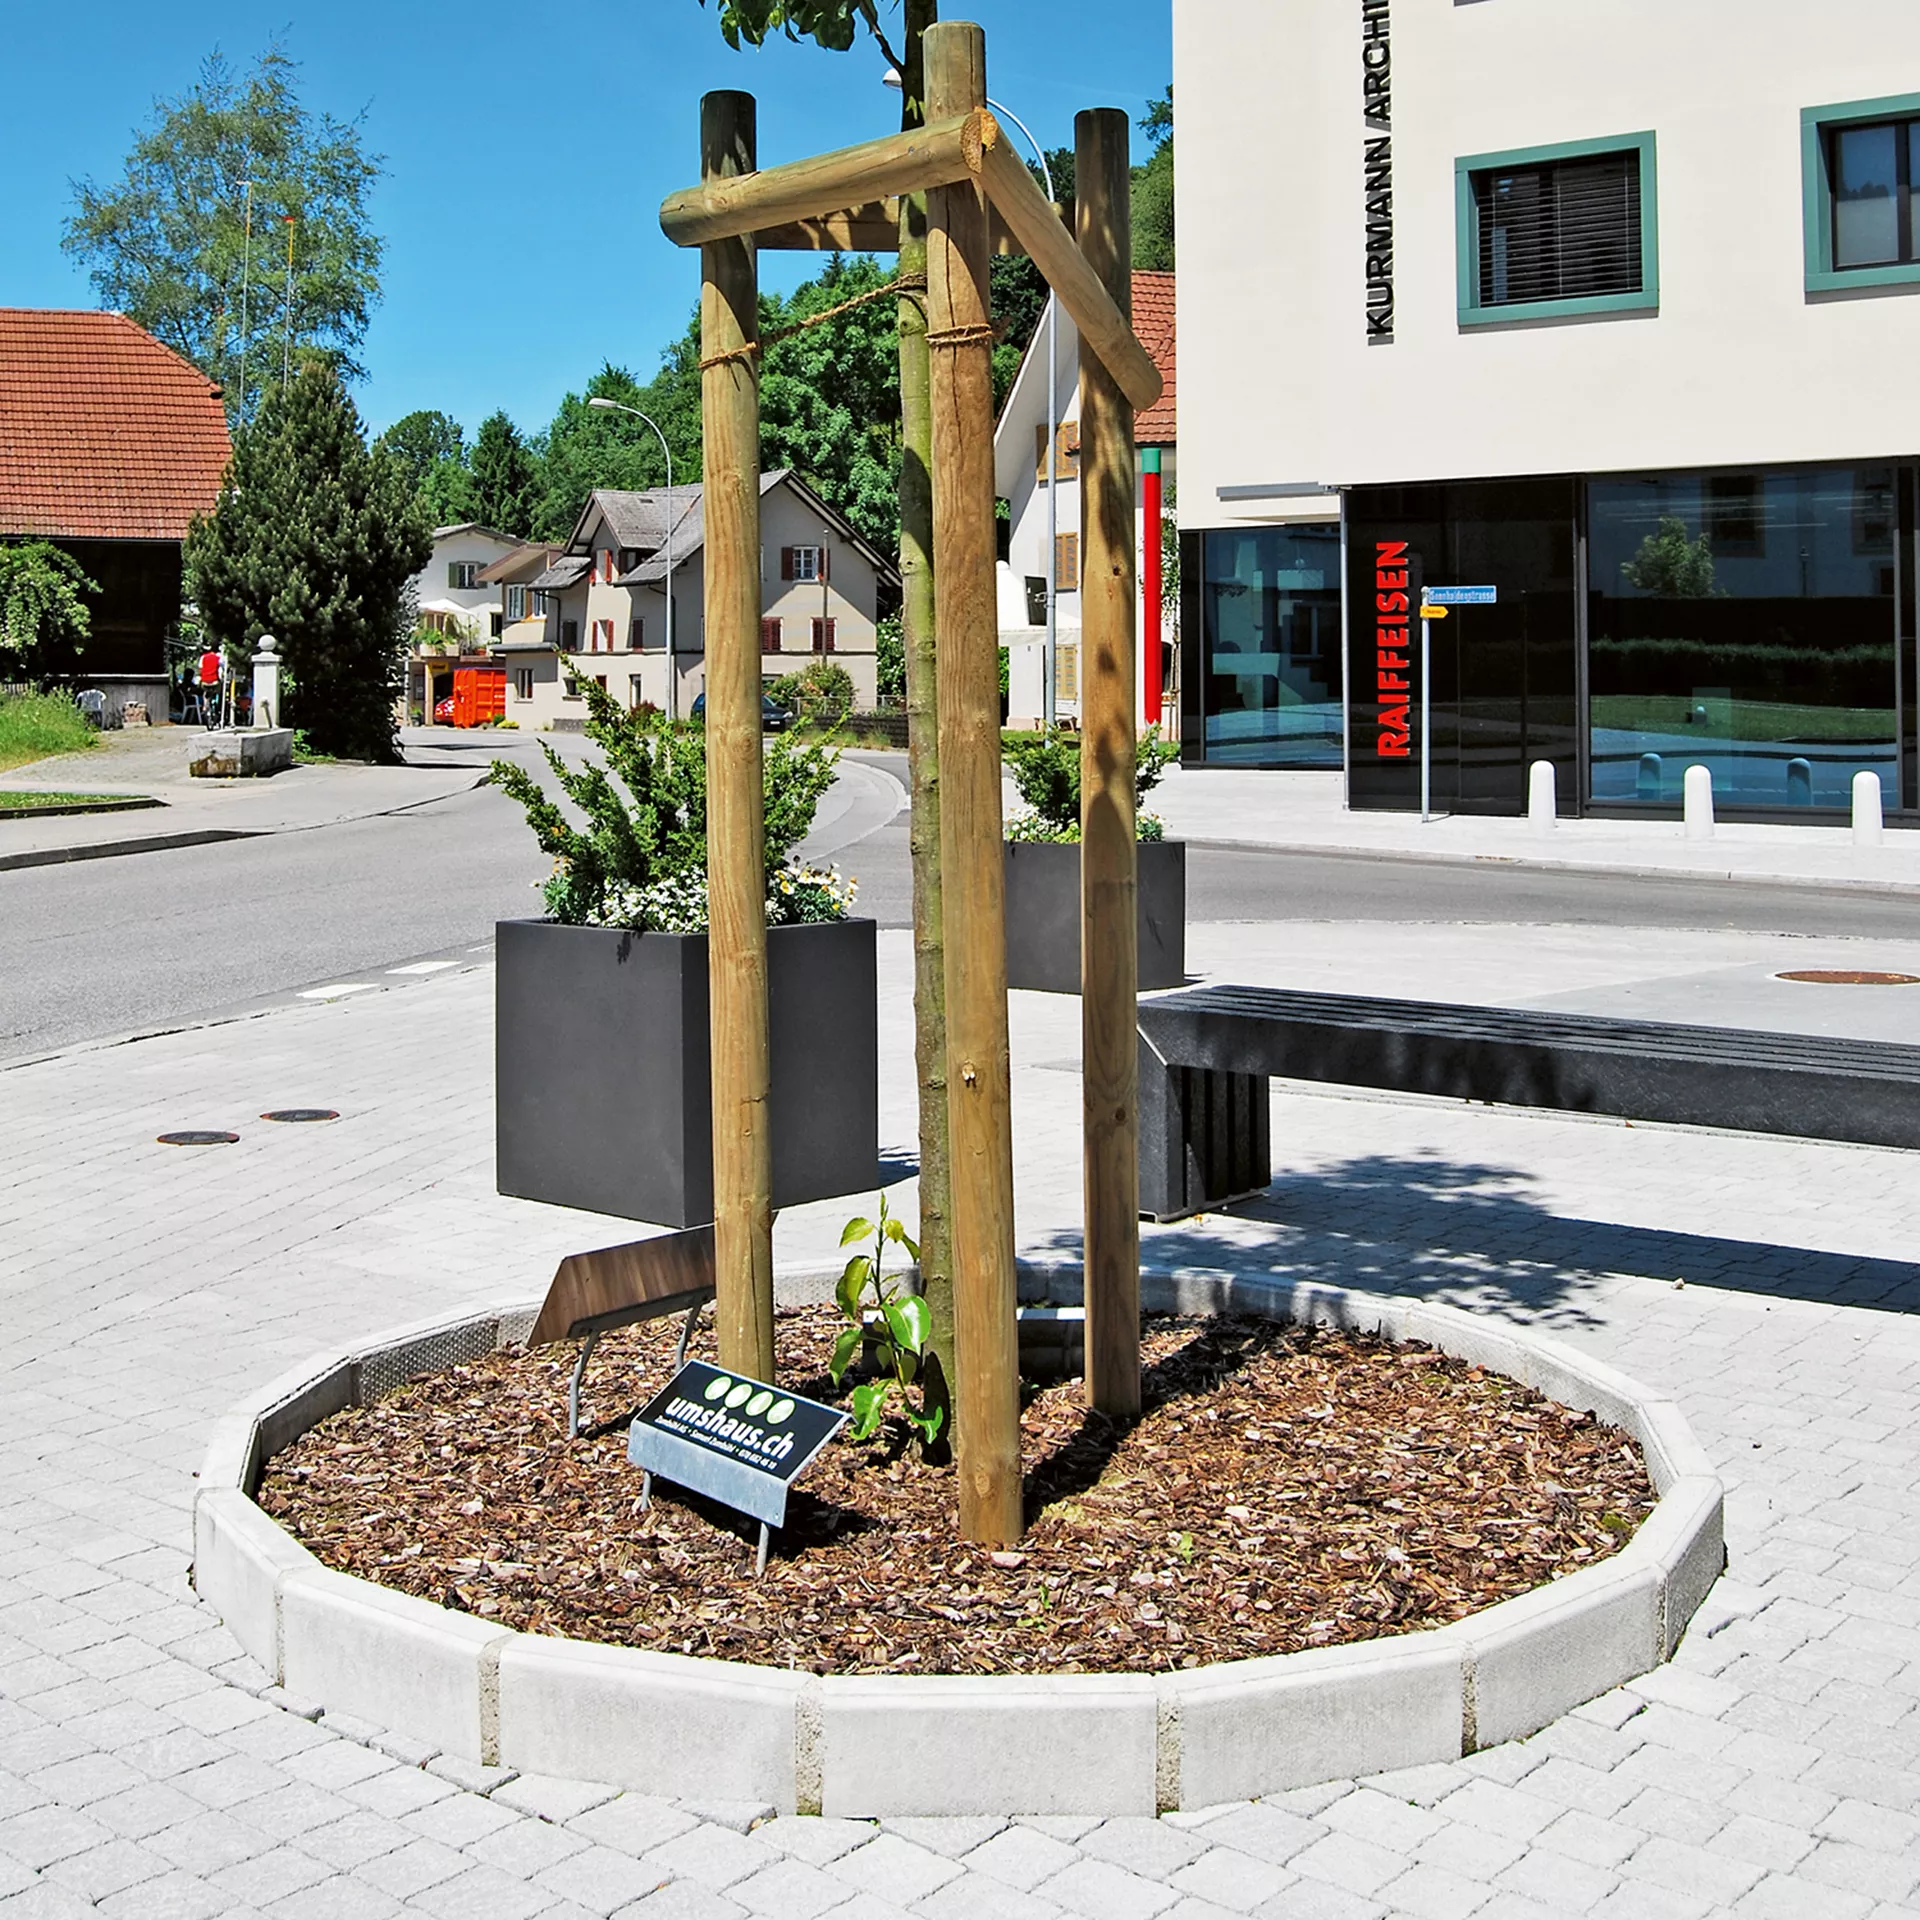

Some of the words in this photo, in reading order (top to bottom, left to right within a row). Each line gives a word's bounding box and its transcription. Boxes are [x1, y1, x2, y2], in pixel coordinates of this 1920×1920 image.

[1362, 0, 1391, 122] ARCHI
[1363, 136, 1393, 336] KURMANN
[1376, 541, 1410, 757] RAIFFEISEN
[664, 1396, 795, 1460] umshaus.ch
